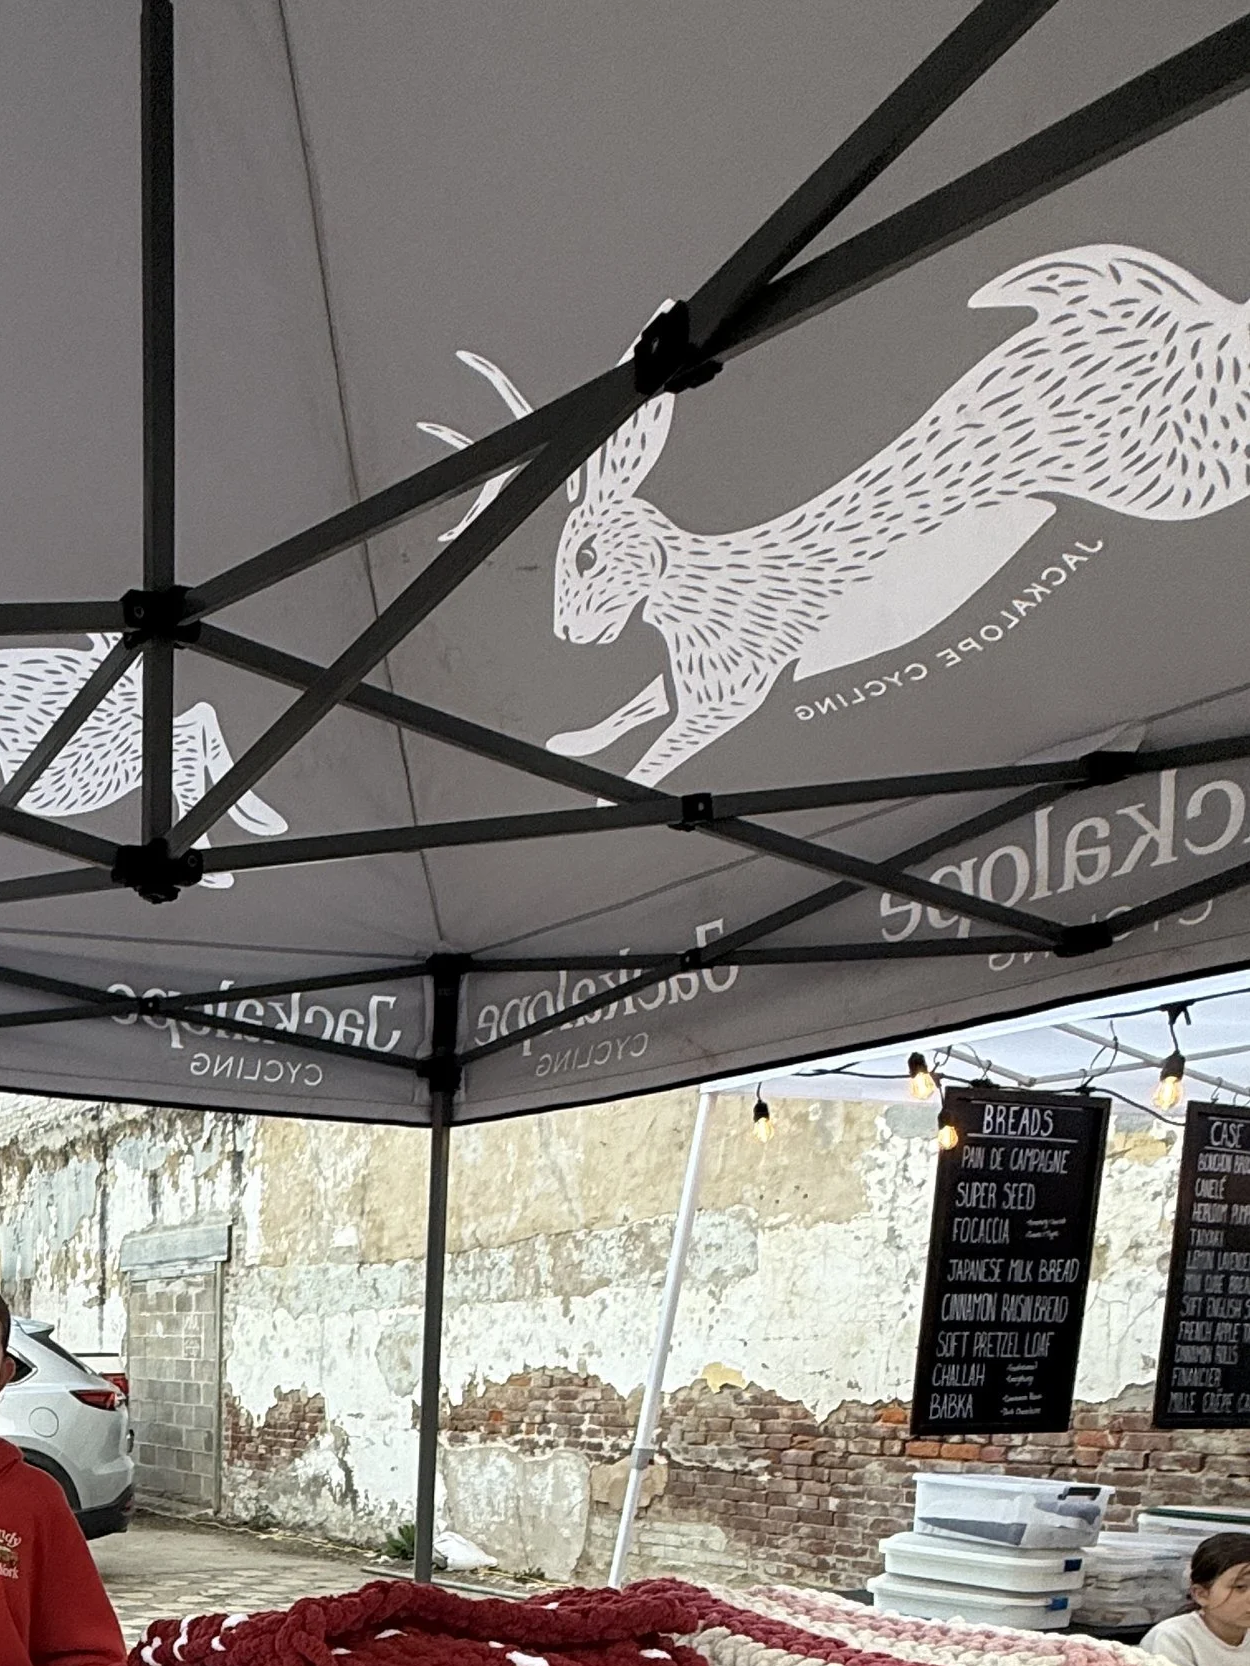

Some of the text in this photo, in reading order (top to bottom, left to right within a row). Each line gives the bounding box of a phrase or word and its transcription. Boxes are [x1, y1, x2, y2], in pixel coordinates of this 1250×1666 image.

[982, 1104, 1054, 1137] BREADS
[1210, 1121, 1244, 1148] CASE
[961, 1145, 1071, 1174] PAIN DE CAMPAGNE
[955, 1181, 1036, 1210] SUPER SEED
[952, 1217, 1010, 1244] FOCACCIA
[947, 1258, 1080, 1283] JAPANESE MILK BREAD
[941, 1292, 1069, 1323] CINNAMON RAISIN BREAD
[936, 1331, 1055, 1358] SOFT PRETZEL LOAF
[932, 1363, 986, 1387] CHALLAH
[929, 1393, 974, 1420] BABKA
